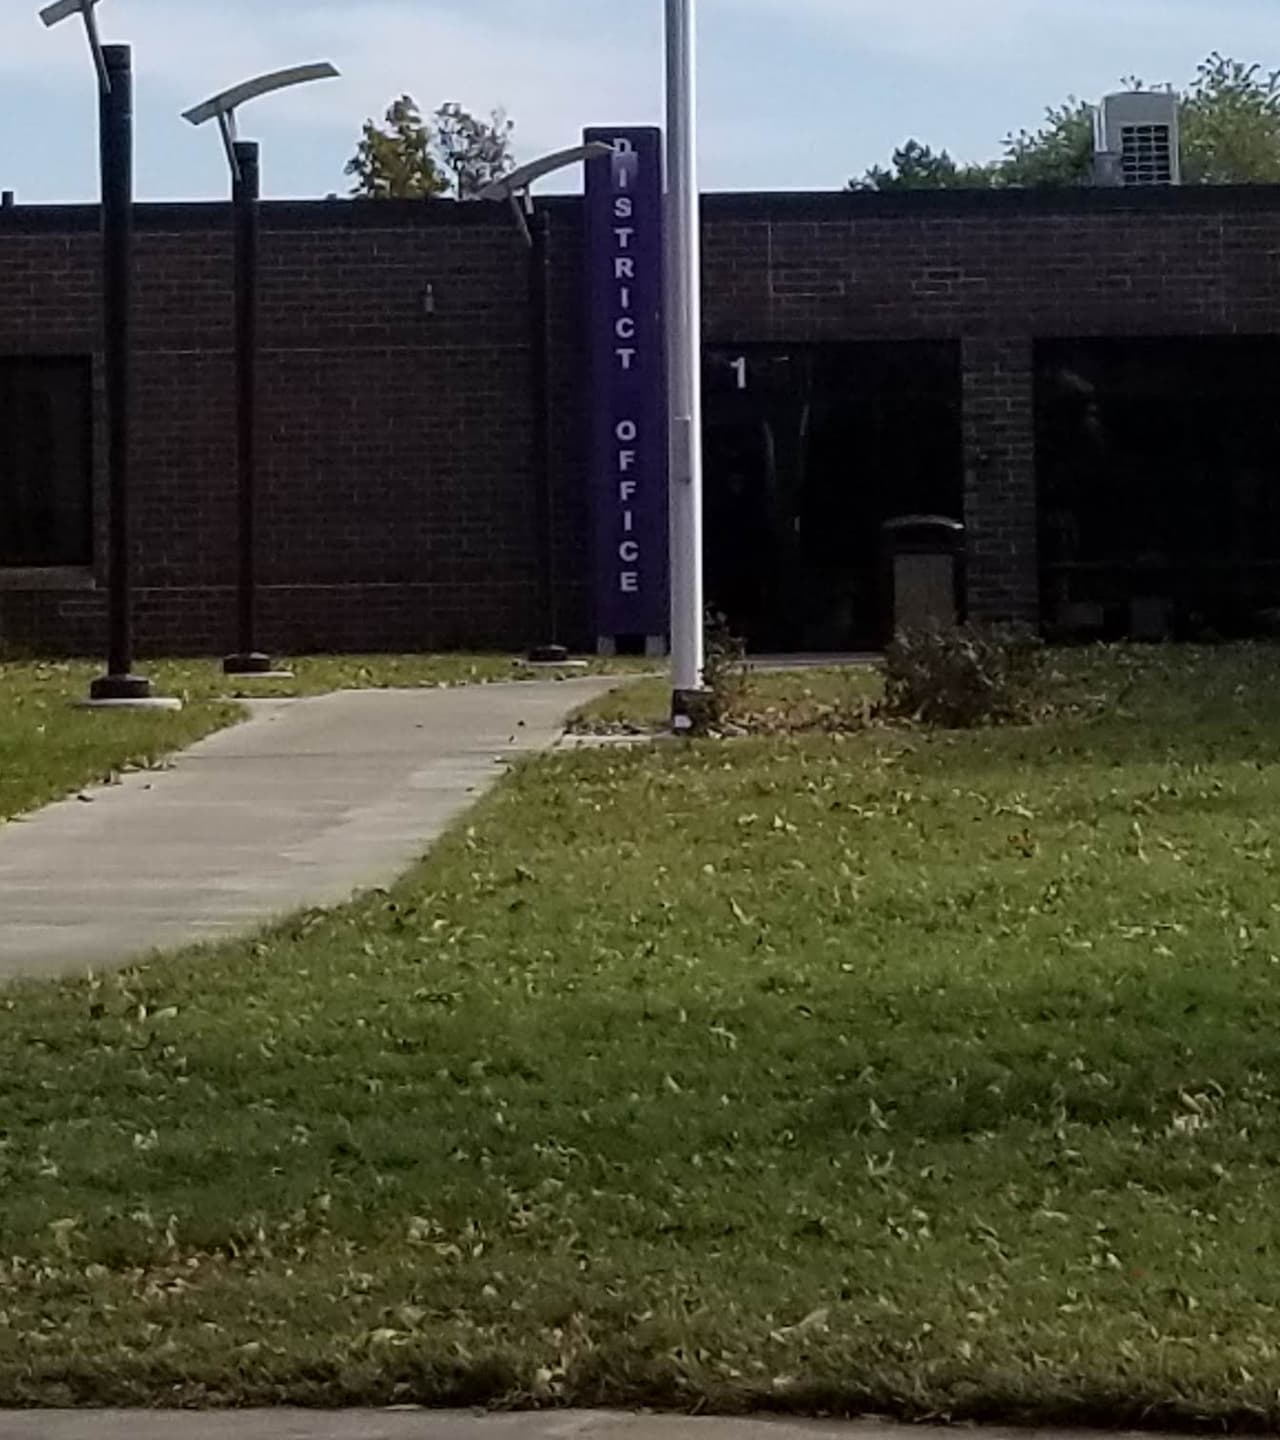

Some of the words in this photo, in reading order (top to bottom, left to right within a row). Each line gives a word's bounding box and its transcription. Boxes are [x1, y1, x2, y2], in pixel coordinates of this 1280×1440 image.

[613, 137, 636, 369] DISTRICT
[730, 356, 747, 389] 1
[615, 420, 639, 592] OFFICE
